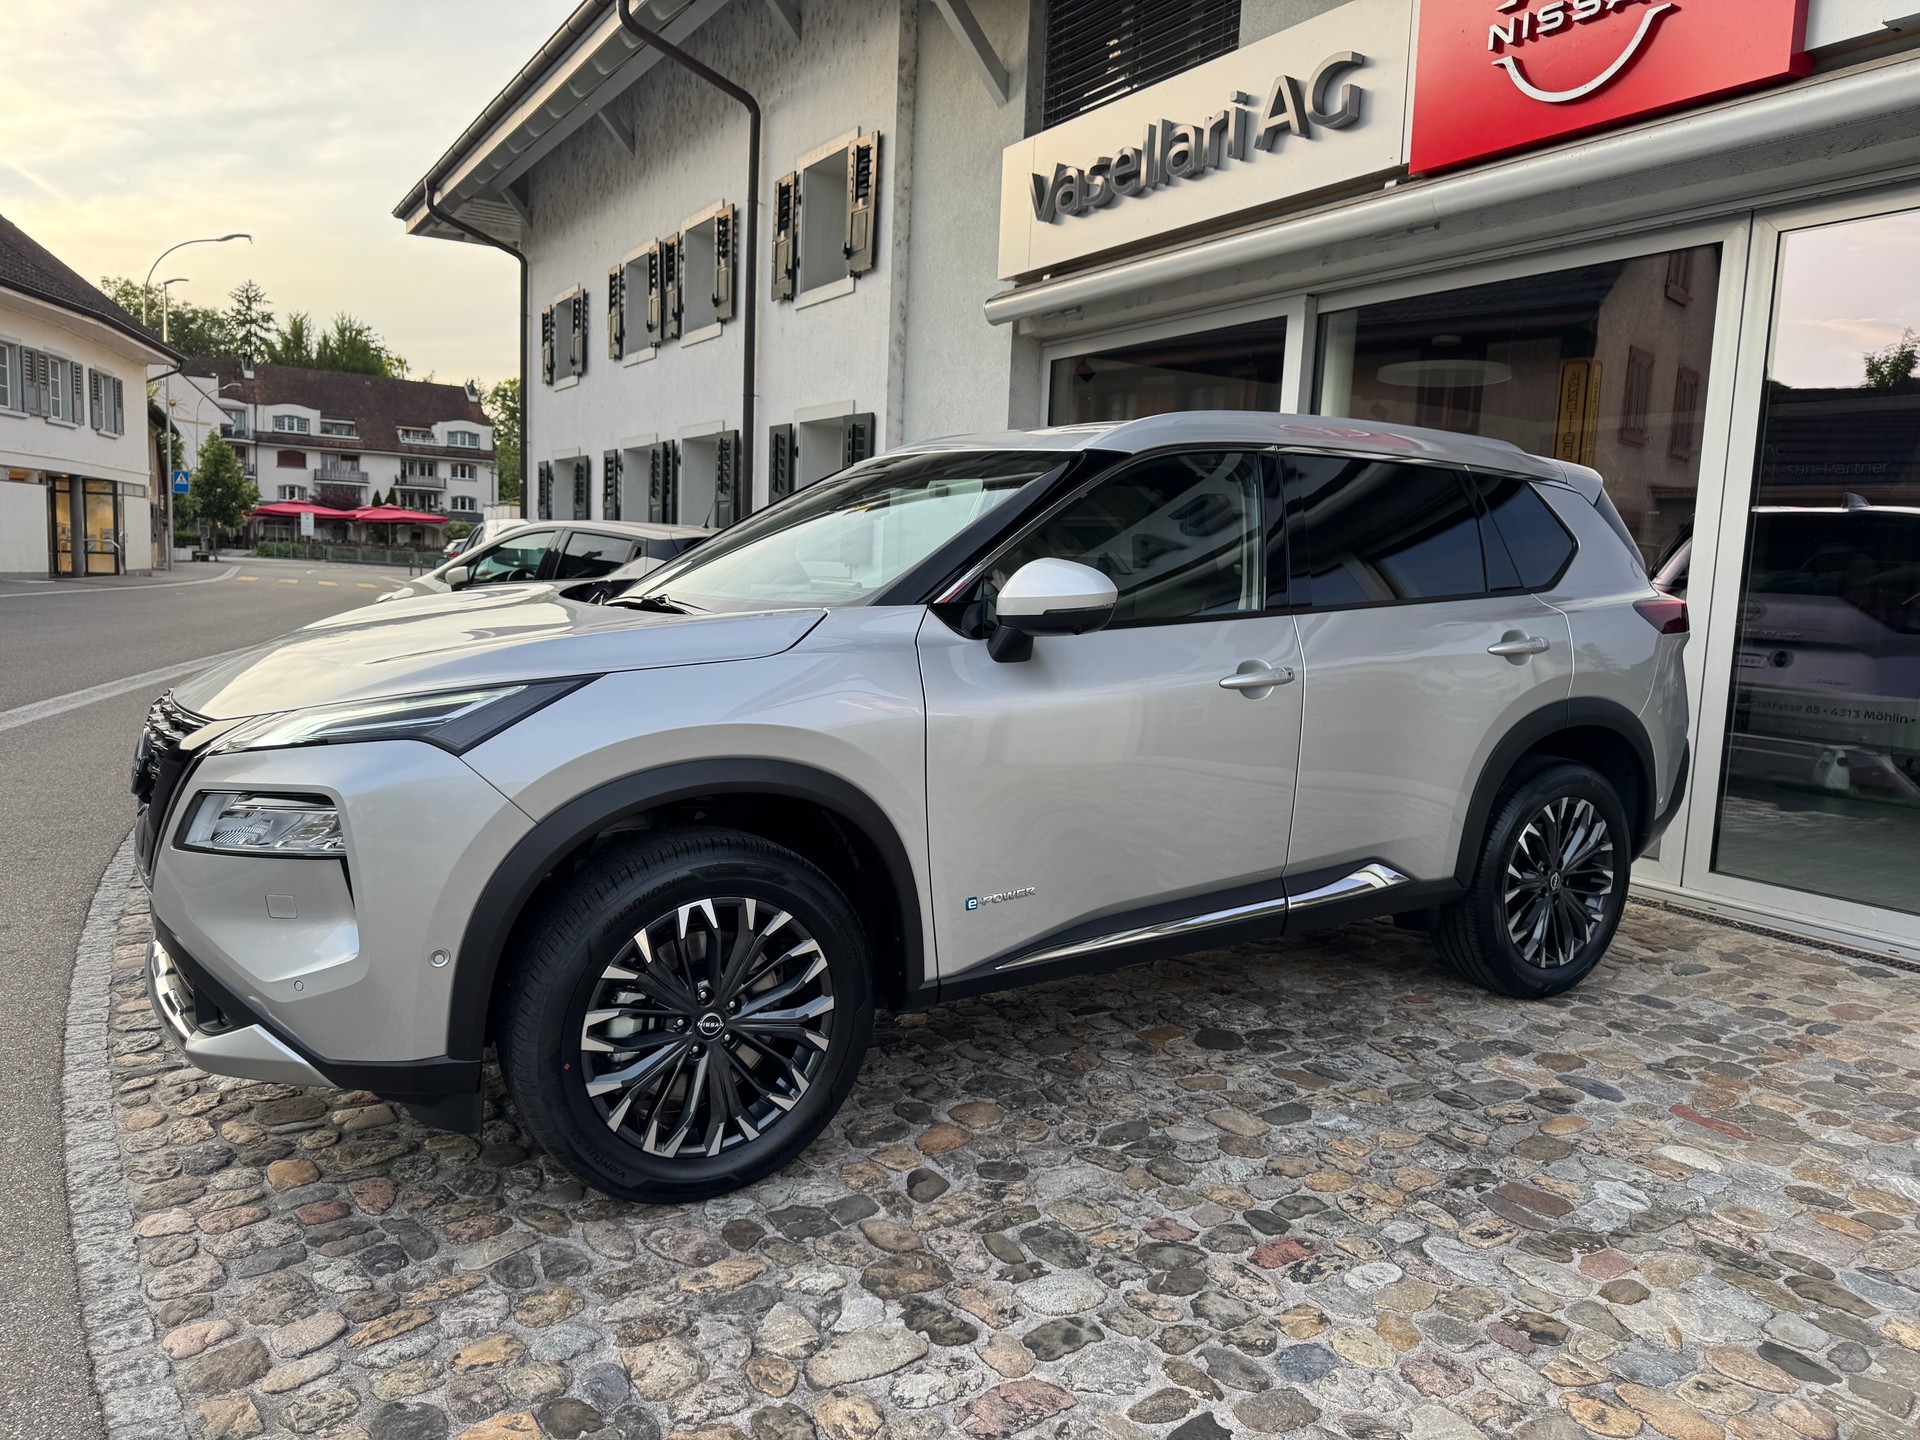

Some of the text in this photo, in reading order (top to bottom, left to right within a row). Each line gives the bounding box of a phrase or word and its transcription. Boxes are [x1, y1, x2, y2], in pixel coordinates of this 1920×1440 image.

[1487, 0, 1620, 51] NISS
[1027, 50, 1364, 223] Vasellari AG
[1763, 462, 1890, 476] Nissan-Partner
[1805, 704, 1820, 714] 65
[1830, 707, 1860, 719] 4313
[1863, 711, 1908, 724] Möhlin
